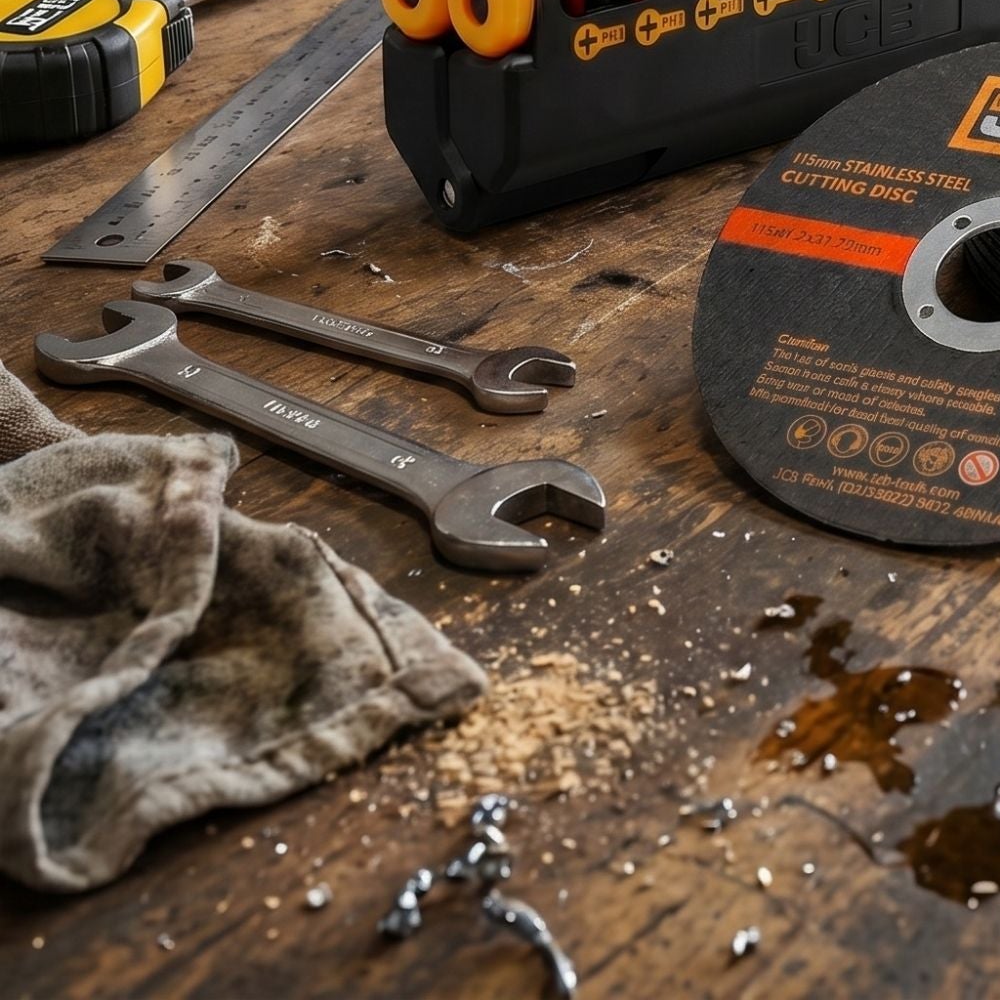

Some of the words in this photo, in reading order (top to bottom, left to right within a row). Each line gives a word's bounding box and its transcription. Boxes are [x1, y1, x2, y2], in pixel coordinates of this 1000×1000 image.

[780, 169, 867, 196] CUTTING
[869, 183, 918, 205] DISC
[792, 152, 841, 171] 115mm
[841, 159, 927, 185] STAINLESS
[926, 172, 972, 193] STEEL
[896, 374, 920, 387] and
